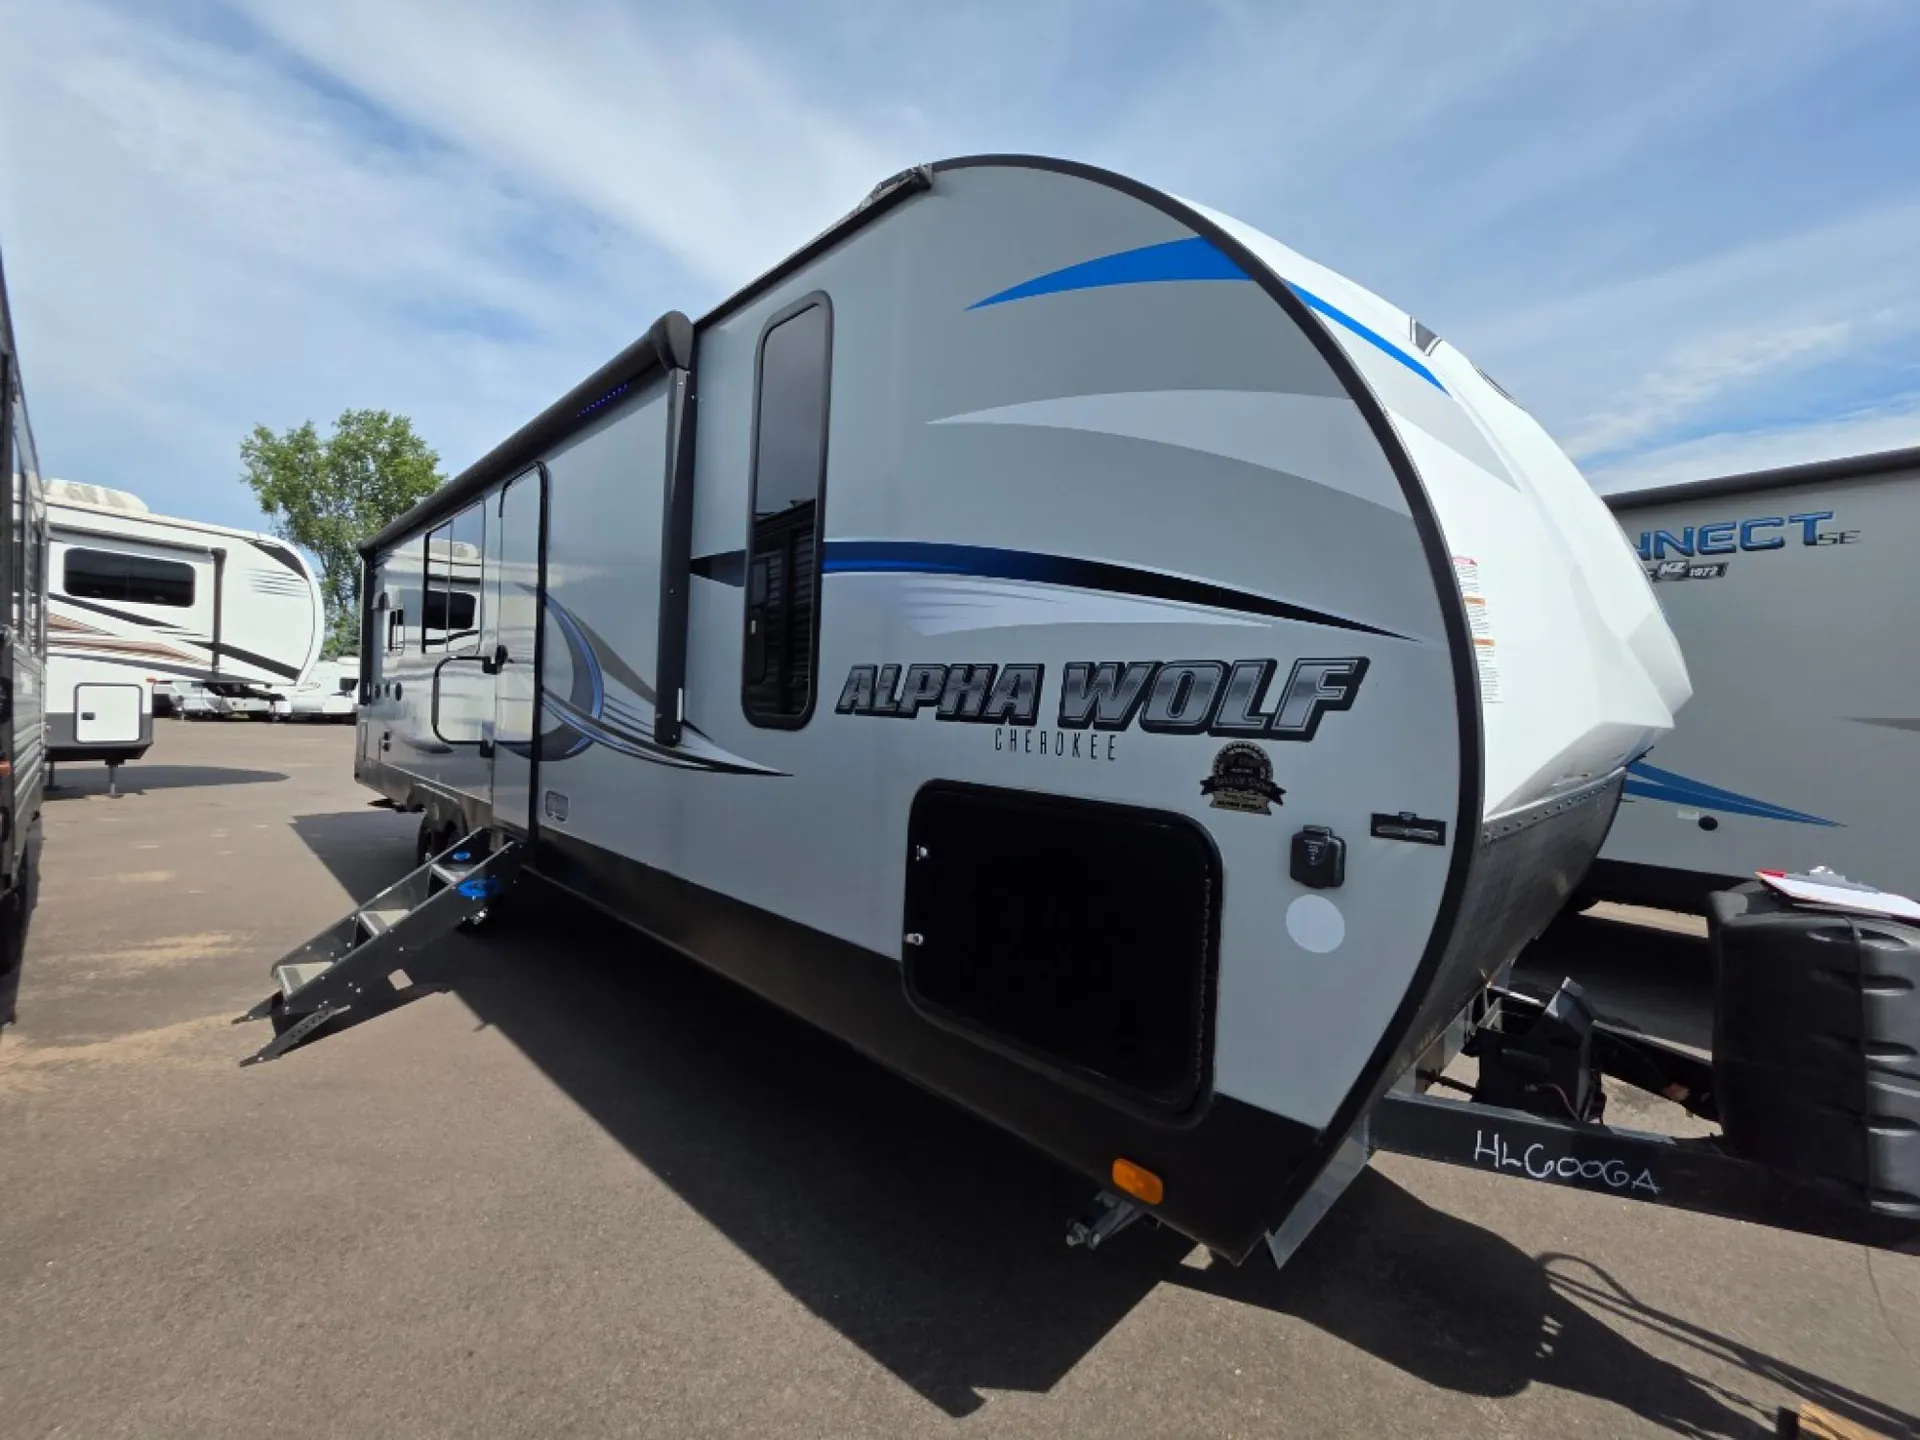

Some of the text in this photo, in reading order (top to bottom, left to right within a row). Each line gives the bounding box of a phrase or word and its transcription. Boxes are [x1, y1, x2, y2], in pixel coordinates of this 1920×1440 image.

[1818, 530, 1861, 547] SE
[834, 656, 1371, 742] ALPHA WOLF
[995, 727, 1116, 760] CHEROKEE
